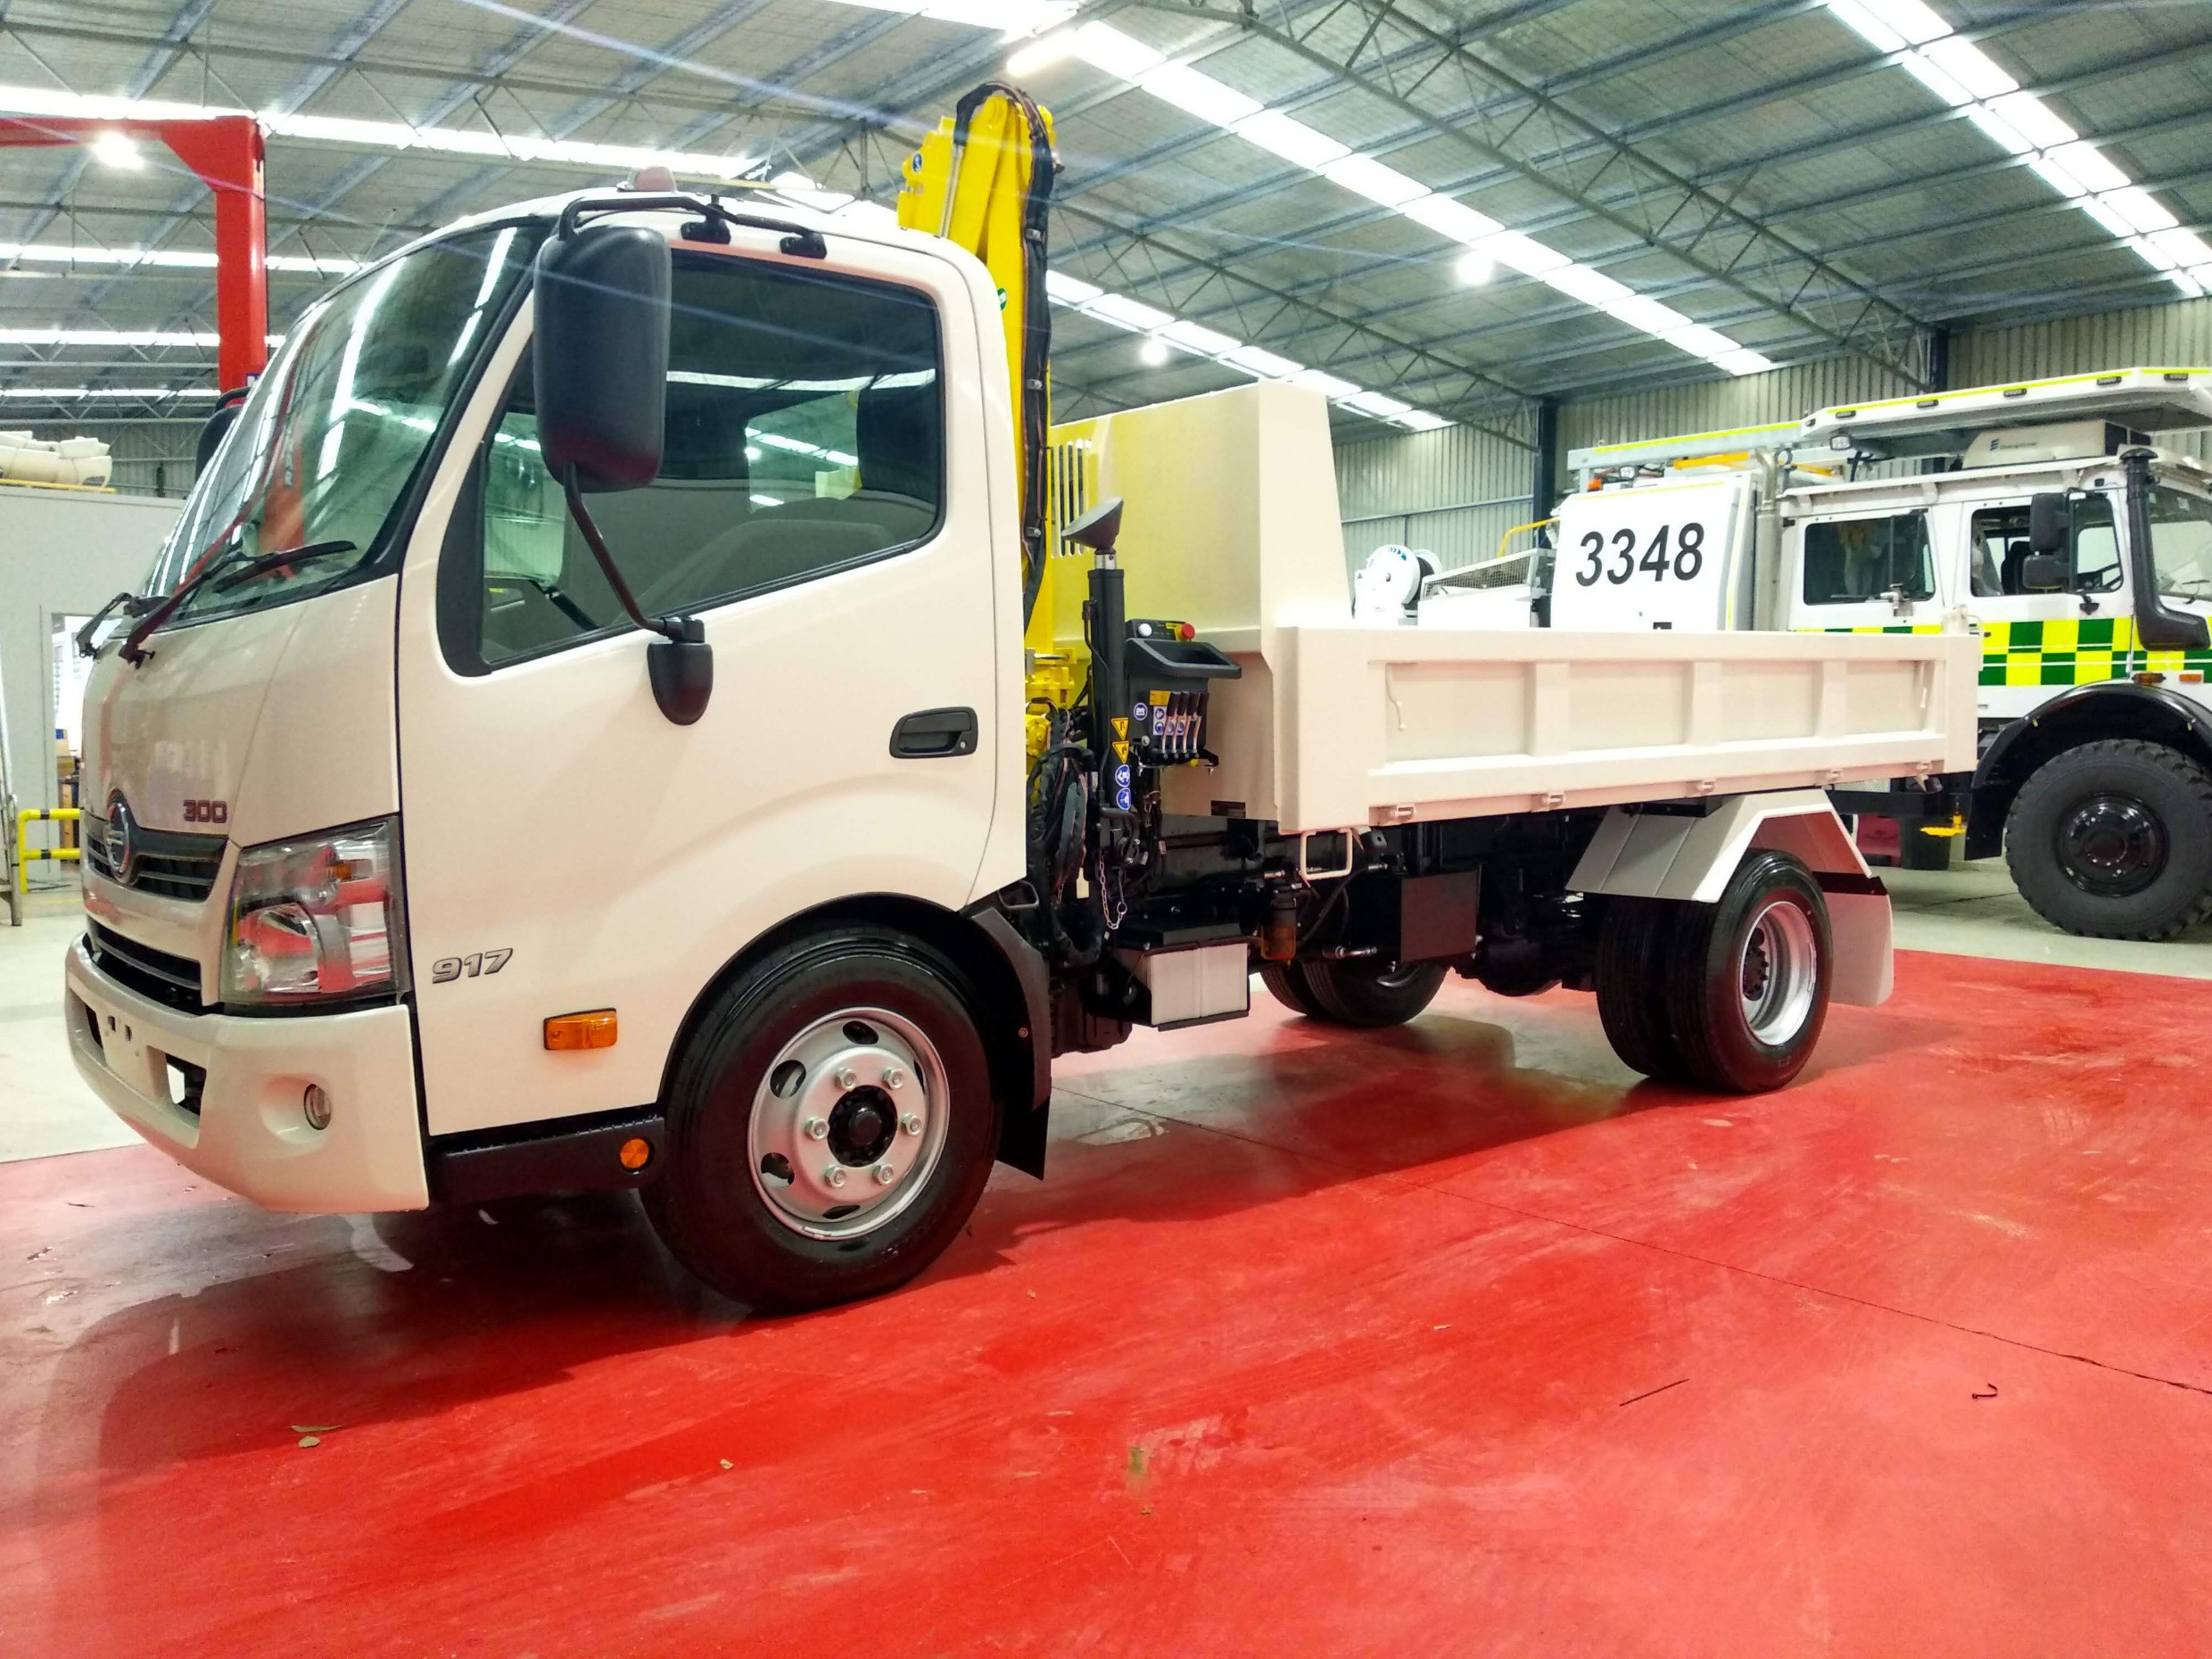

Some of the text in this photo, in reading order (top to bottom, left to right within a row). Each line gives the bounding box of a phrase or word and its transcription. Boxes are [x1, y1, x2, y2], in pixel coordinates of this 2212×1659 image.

[1576, 523, 1704, 587] 3348
[183, 800, 227, 823] 300
[433, 948, 513, 984] 917
